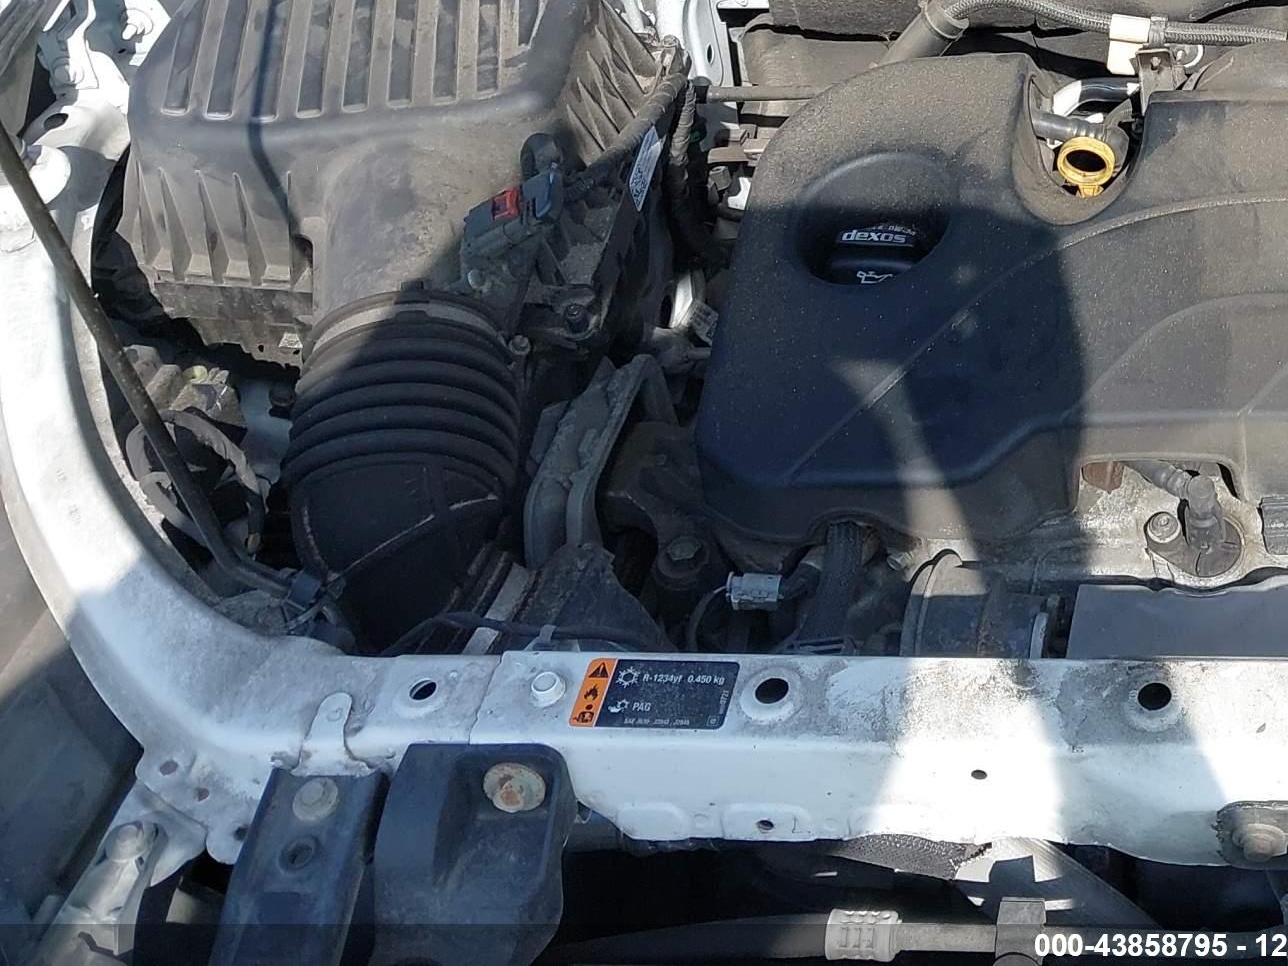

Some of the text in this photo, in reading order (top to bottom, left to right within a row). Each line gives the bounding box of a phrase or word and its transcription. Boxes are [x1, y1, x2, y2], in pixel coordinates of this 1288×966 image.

[841, 229, 906, 243] dexos
[642, 673, 725, 685] R-1234yf 0.450 kg
[632, 702, 651, 712] PAG
